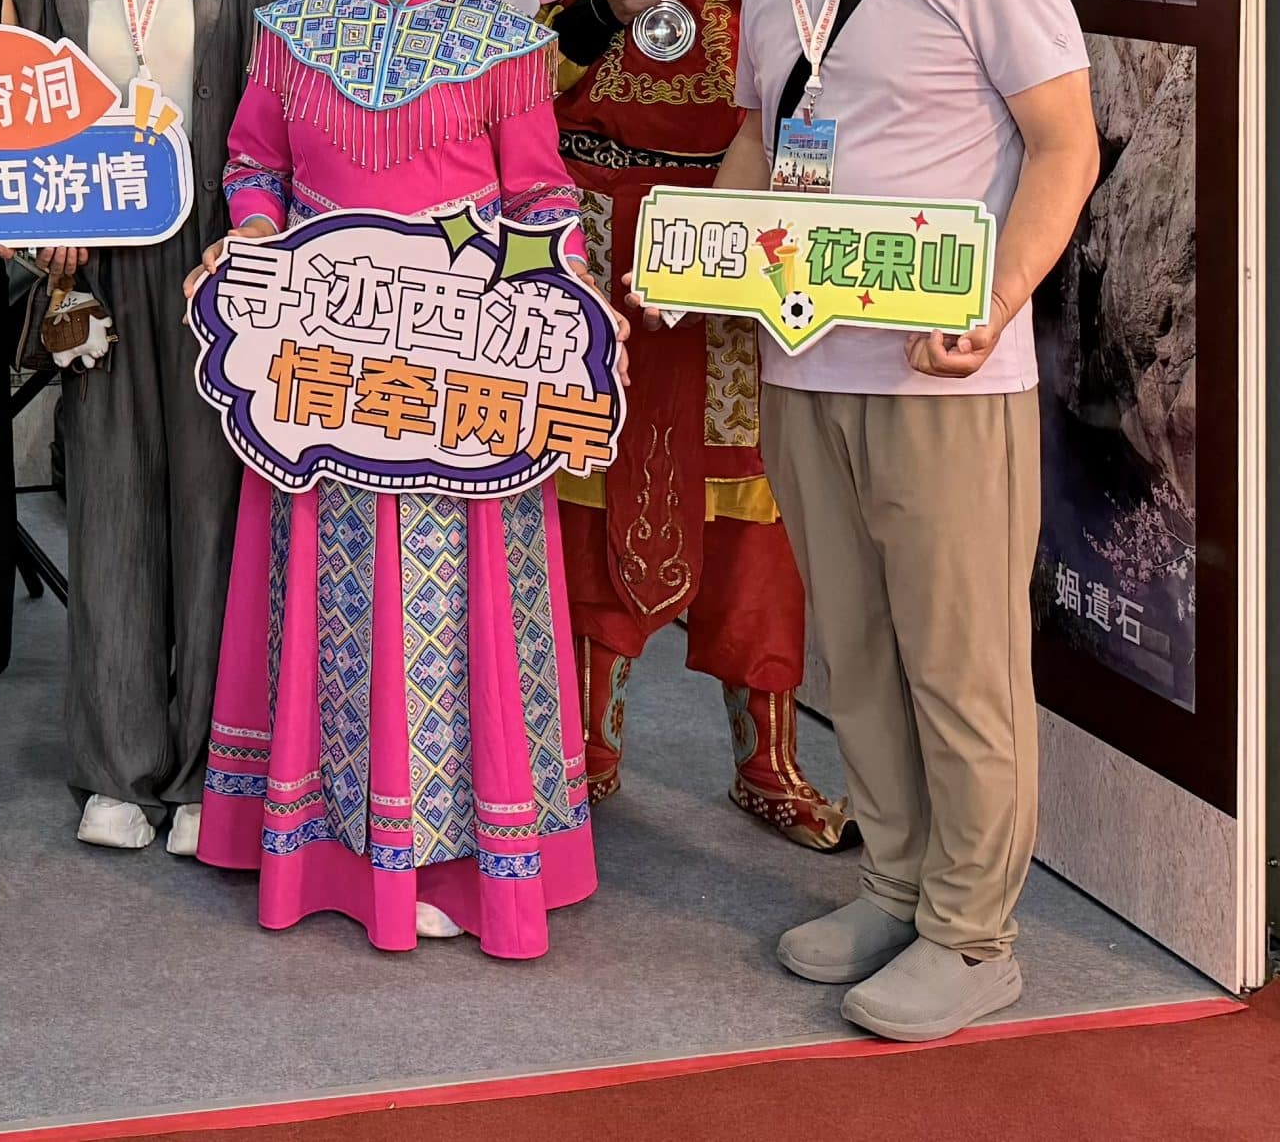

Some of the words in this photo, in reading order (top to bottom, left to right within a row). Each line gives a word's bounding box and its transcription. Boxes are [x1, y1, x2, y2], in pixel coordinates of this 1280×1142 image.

[217, 241, 582, 373] 寻迹西游
[646, 217, 749, 279] 冲鸭
[805, 226, 976, 296] 花果山
[266, 339, 613, 471] 情牵两岸
